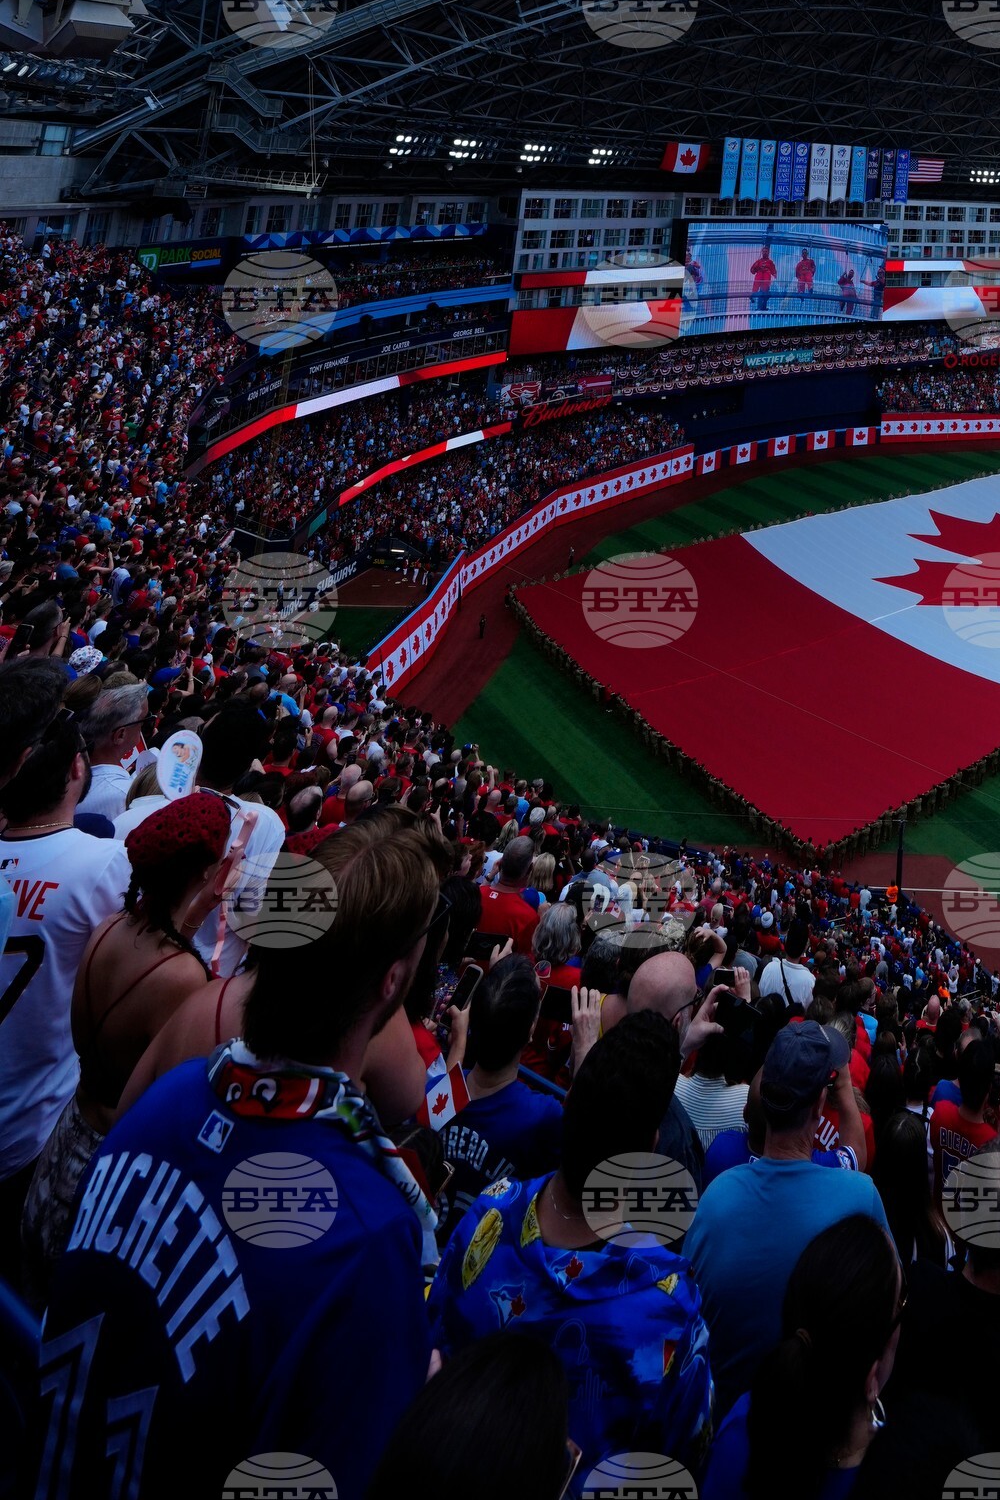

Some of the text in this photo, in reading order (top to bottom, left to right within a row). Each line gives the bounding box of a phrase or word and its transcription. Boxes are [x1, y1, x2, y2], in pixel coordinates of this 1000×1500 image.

[813, 158, 829, 168] 1992
[834, 159, 849, 169] 1993
[140, 247, 222, 271] TD PARK SOCIAL
[452, 329, 473, 338] GEORGE
[380, 341, 411, 353] JOE CARTER
[309, 355, 350, 375] TONY FERNANDEZ
[746, 354, 786, 367] WESTJET
[521, 394, 614, 429] Budweiser
[315, 561, 358, 596] SUBWAY
[66, 1150, 251, 1385] BICHETTE
